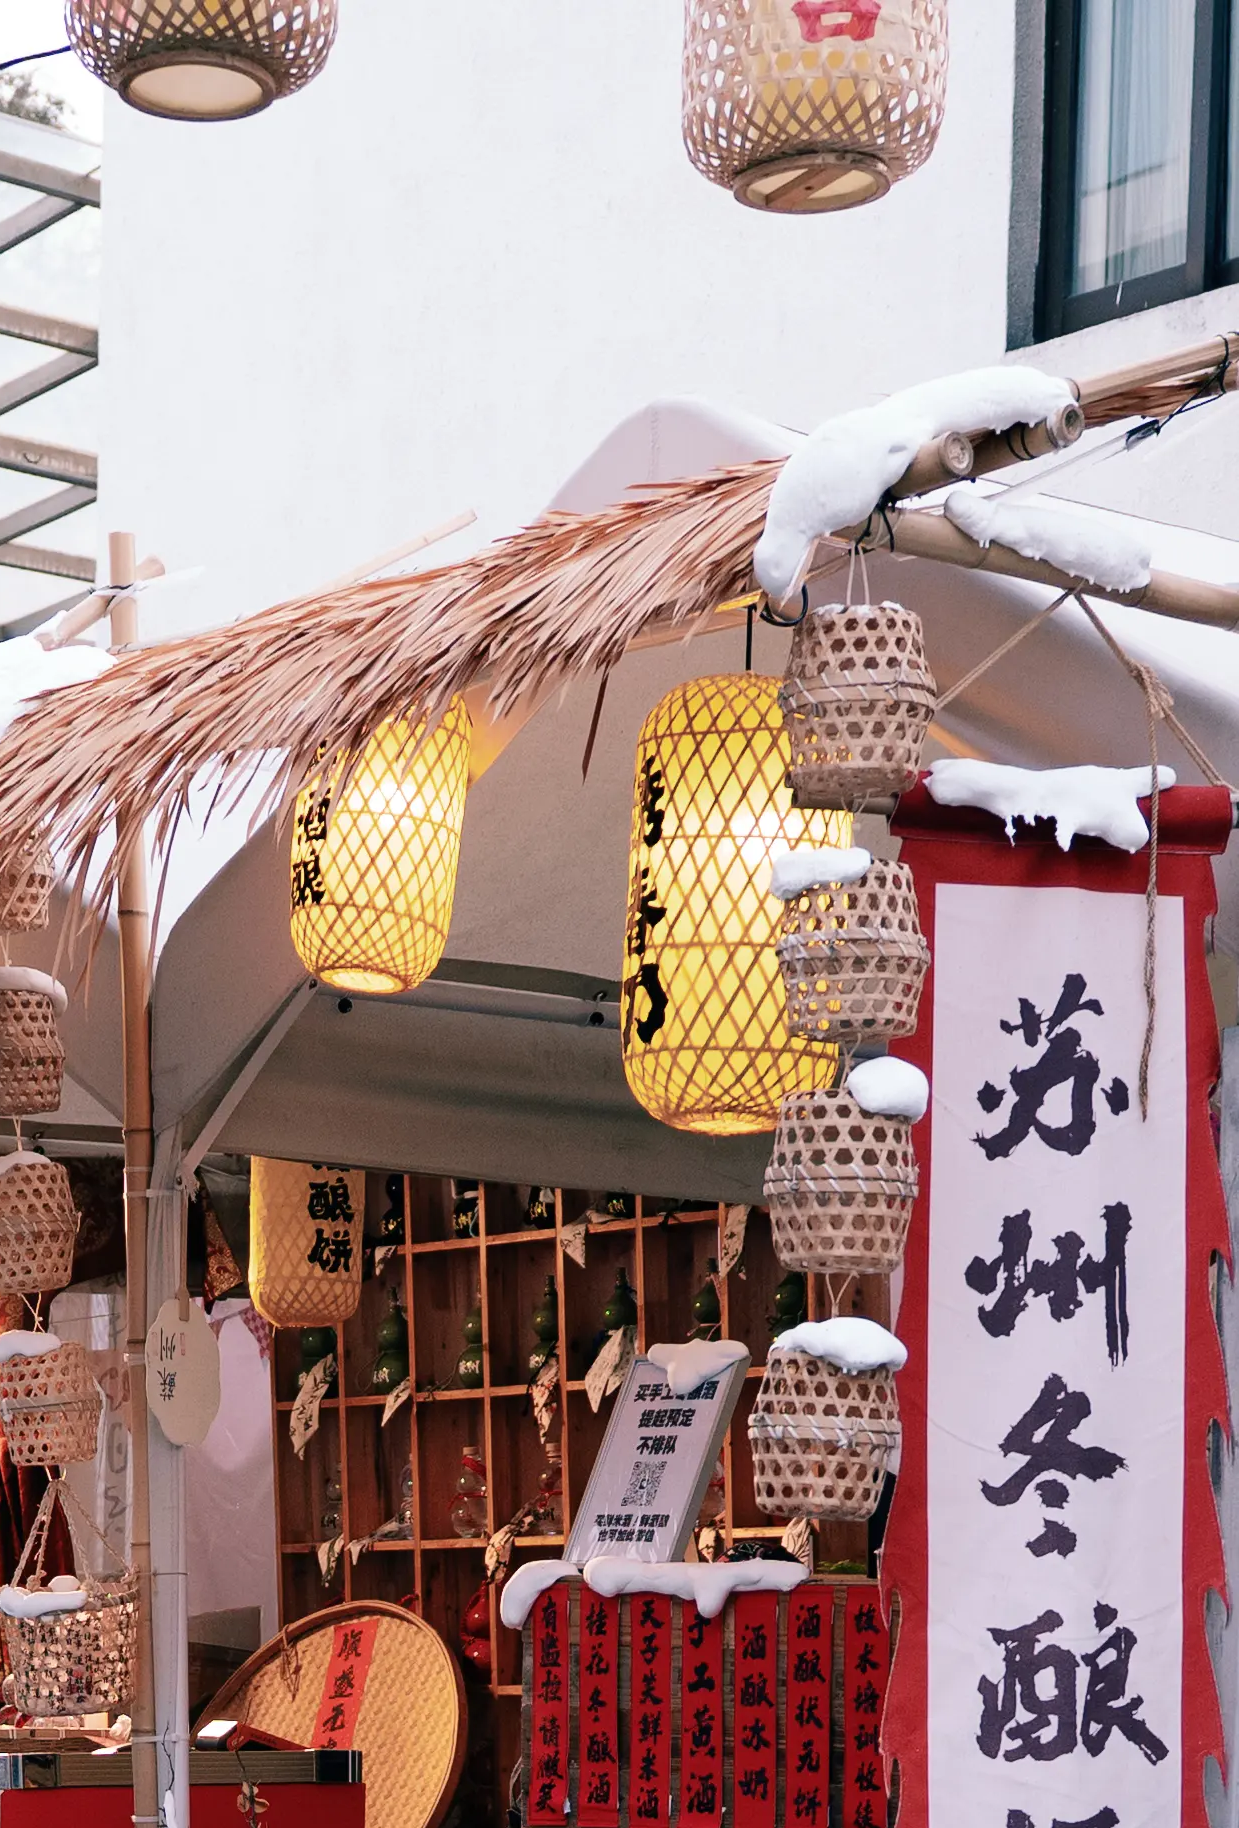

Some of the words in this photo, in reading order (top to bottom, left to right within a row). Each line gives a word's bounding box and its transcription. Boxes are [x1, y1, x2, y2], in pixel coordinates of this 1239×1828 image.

[307, 1164, 355, 1274] 酿饼
[636, 1435, 679, 1456] 不排队
[585, 1603, 617, 1806] 桂花冬酿酒
[738, 1624, 774, 1802] 酒酿冰奶
[791, 1604, 827, 1826] 酒酿状元饼
